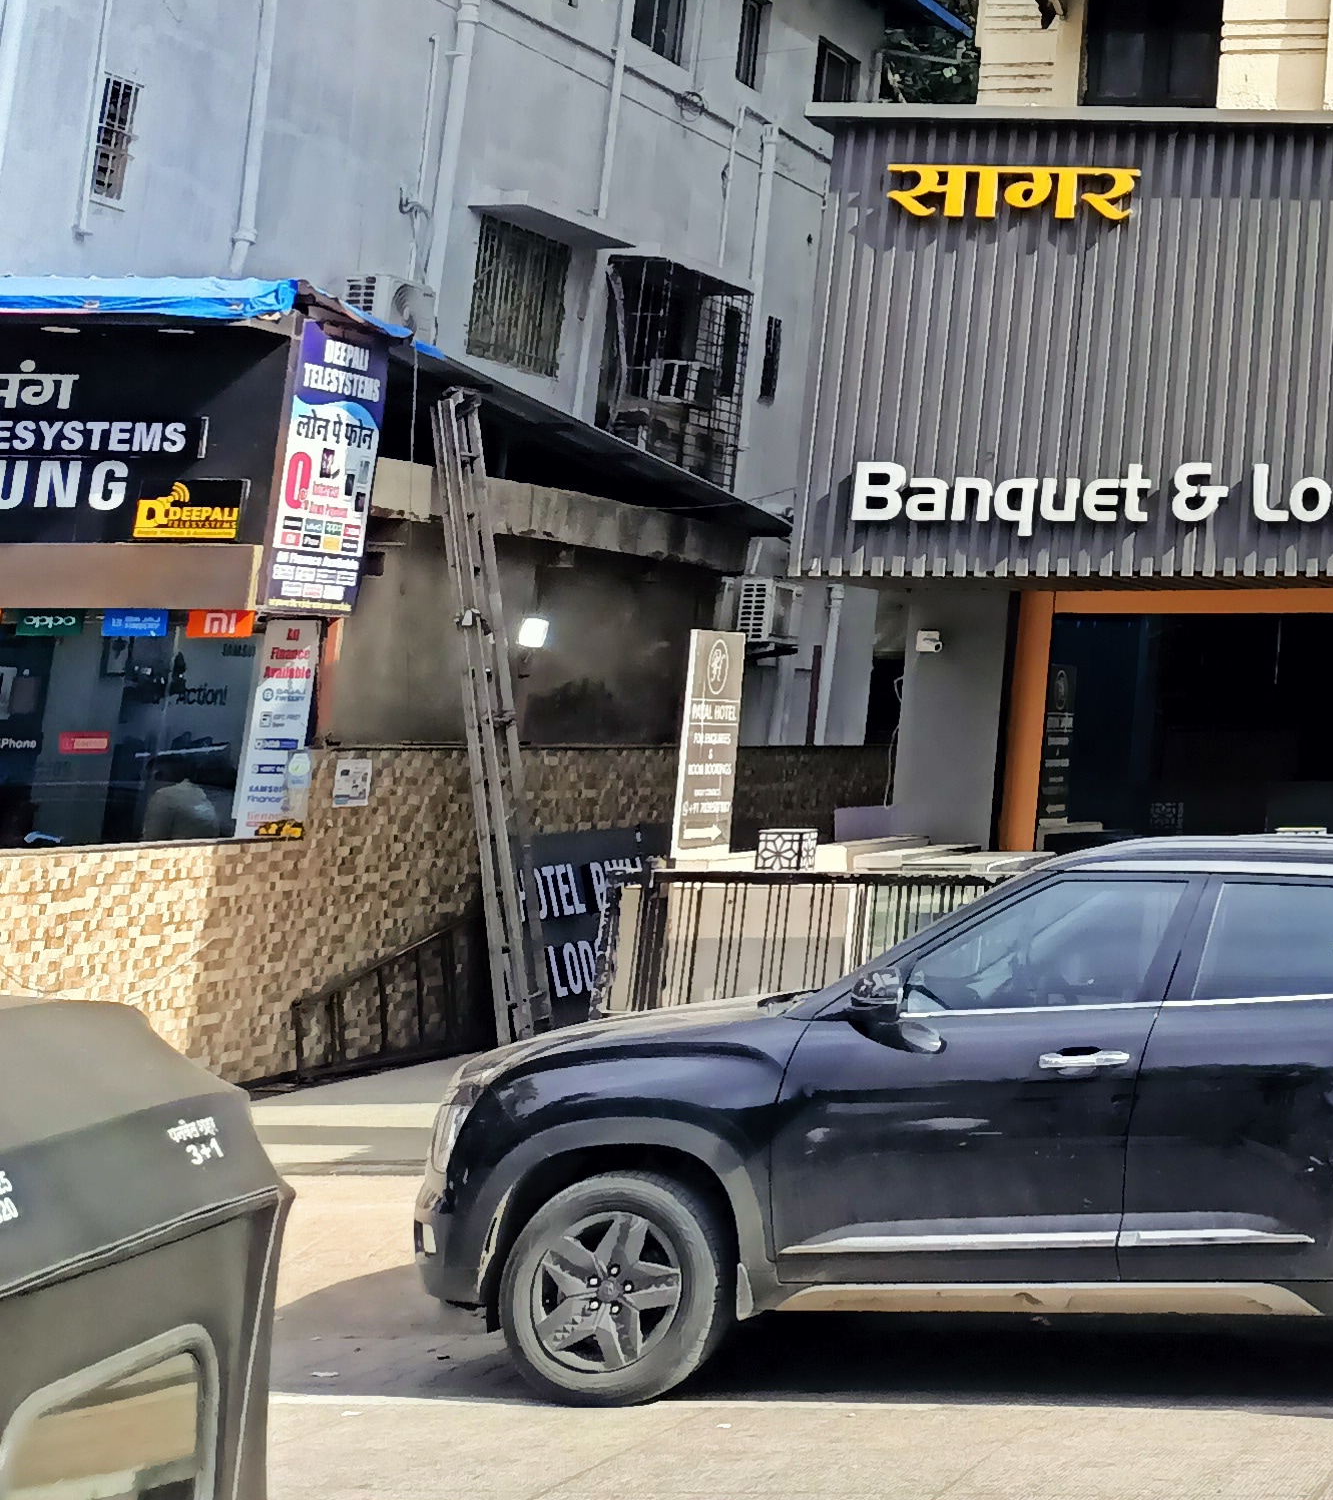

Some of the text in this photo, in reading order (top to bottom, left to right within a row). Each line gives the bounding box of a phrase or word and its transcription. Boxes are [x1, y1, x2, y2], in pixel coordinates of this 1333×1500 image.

[886, 162, 1142, 221] सागर
[323, 338, 370, 372] DEEPALI
[302, 362, 381, 403] TELESYSTEMS
[296, 408, 375, 450] लोन पे फोन
[168, 506, 240, 521] DEEPALI
[850, 461, 1152, 537] Banquet
[1172, 462, 1229, 520] &
